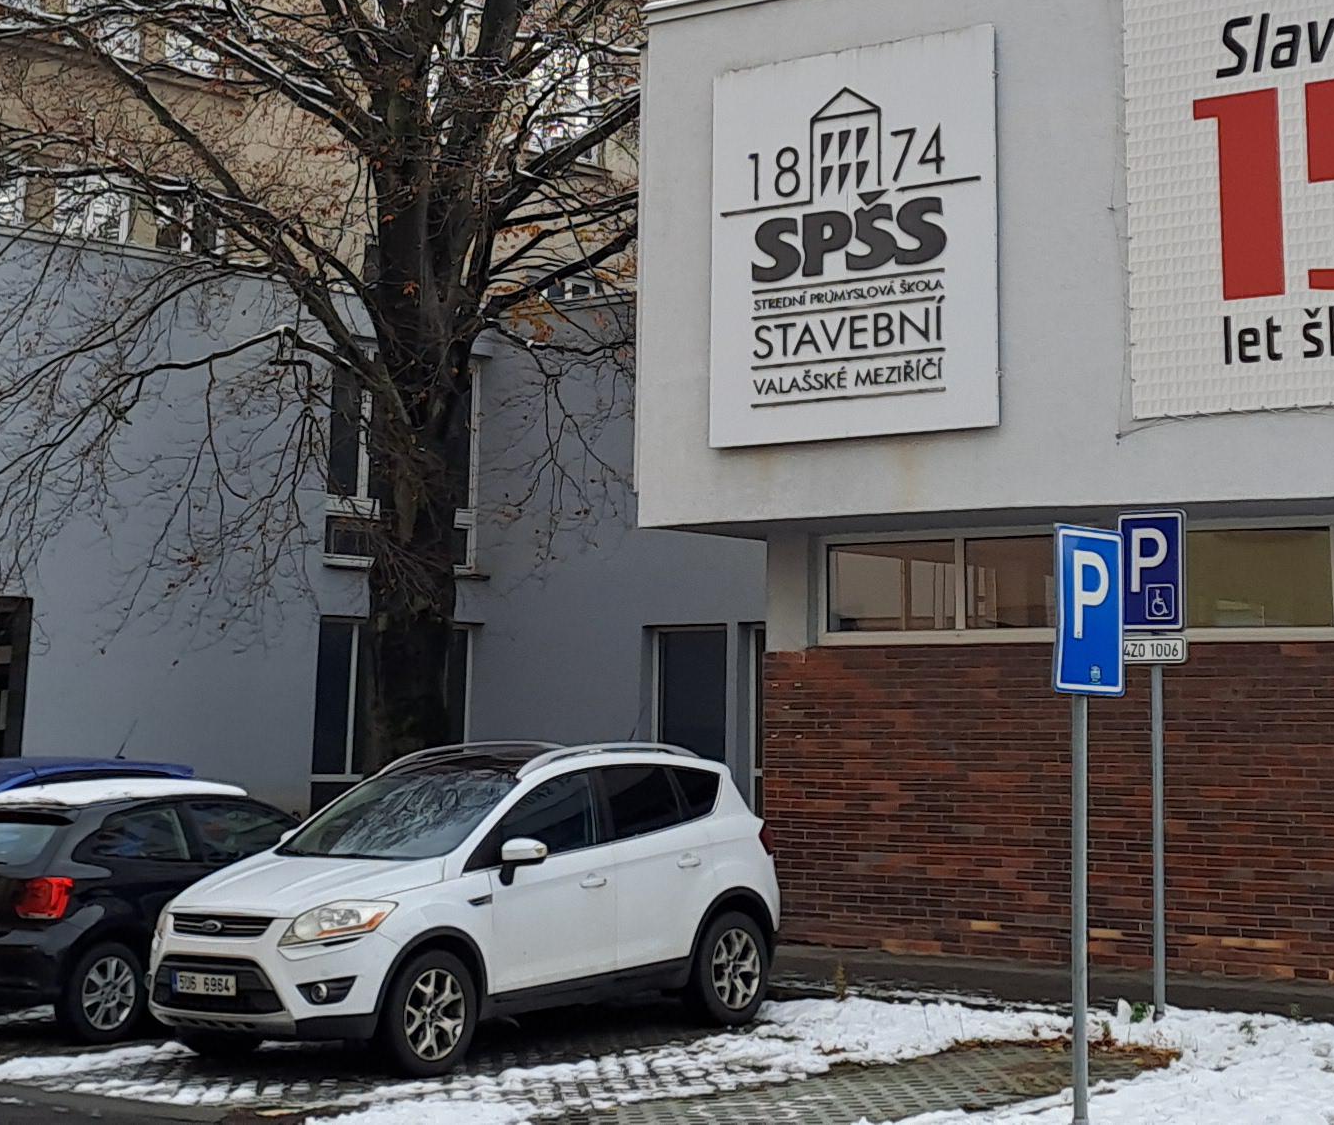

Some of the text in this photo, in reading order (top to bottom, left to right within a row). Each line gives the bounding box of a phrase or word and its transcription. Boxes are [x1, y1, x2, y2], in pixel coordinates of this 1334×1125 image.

[747, 122, 946, 201] 18 74
[750, 187, 948, 284] SPŠS
[899, 278, 945, 295] ŠKOLA
[752, 294, 946, 360] STAVEBNÍ
[1222, 313, 1285, 365] let
[752, 356, 944, 396] VALAŠSKÉ MEZIŘÍČÍ
[1130, 527, 1168, 593] P
[1073, 549, 1109, 639] P
[1150, 642, 1179, 658] 1006
[203, 976, 231, 993] 6964
